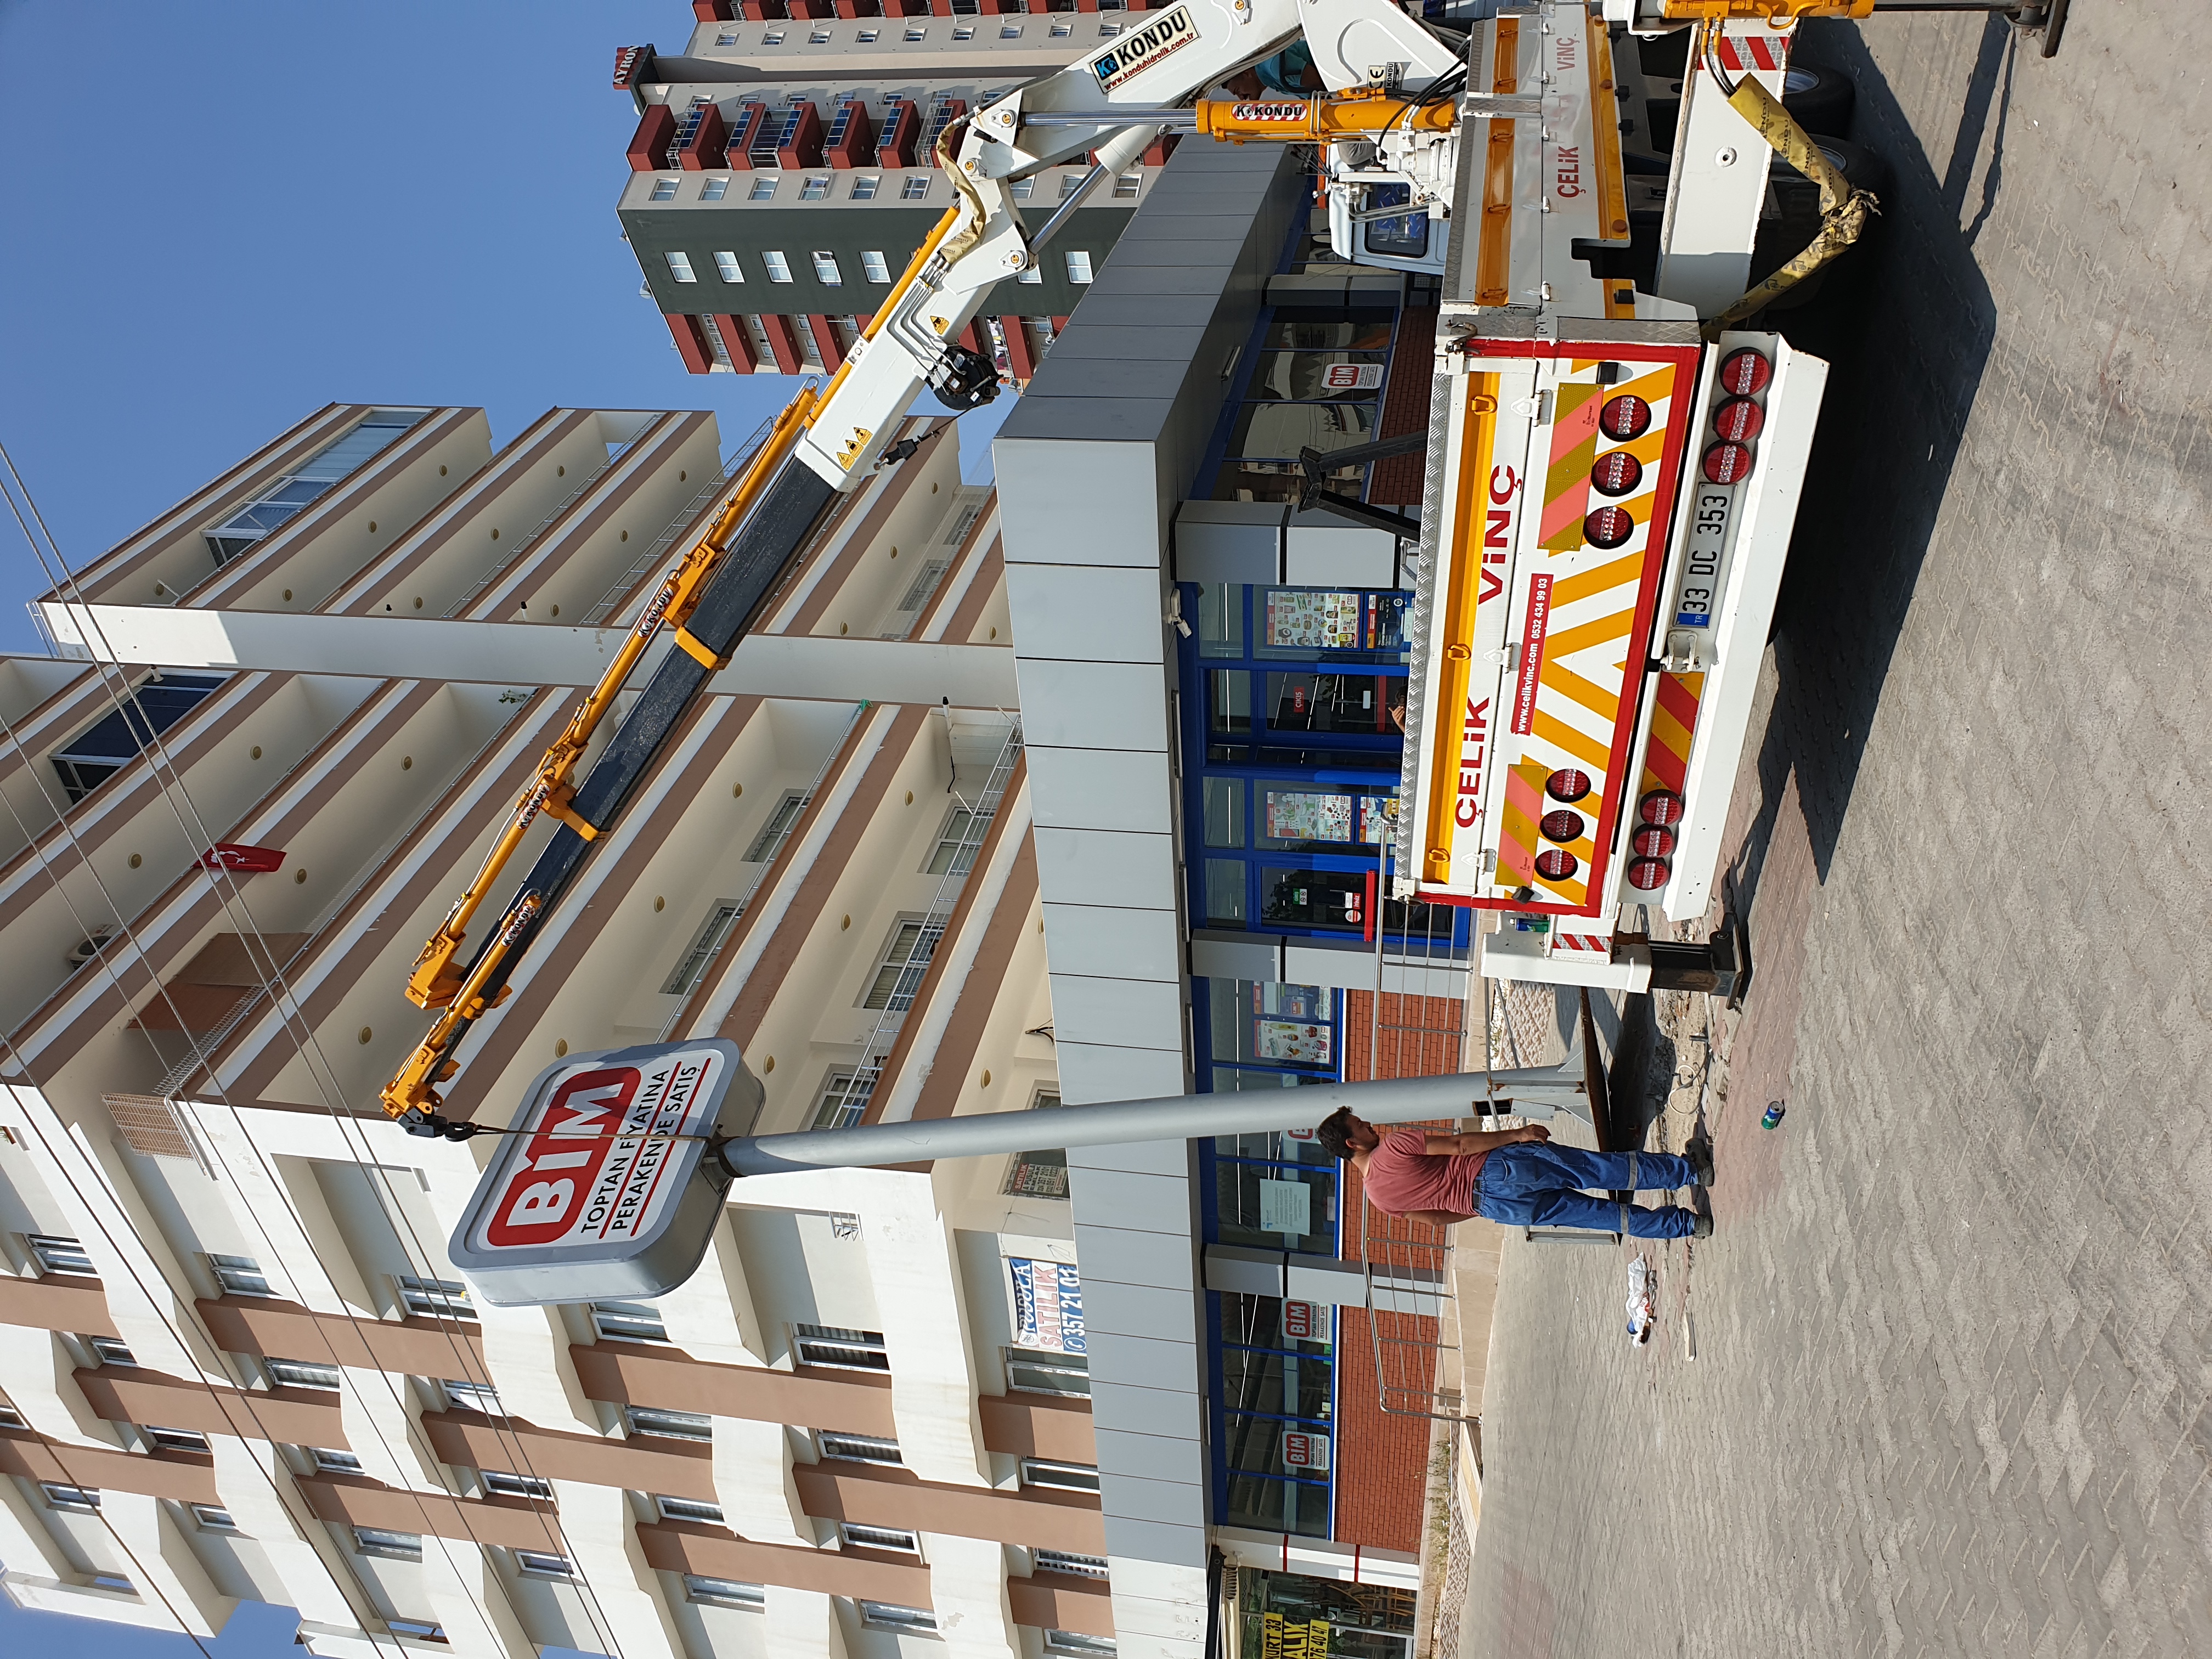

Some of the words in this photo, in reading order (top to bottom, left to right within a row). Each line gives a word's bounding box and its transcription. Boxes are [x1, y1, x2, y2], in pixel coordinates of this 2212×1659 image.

[1114, 8, 1187, 68] KONDU
[613, 44, 640, 84] AYRON
[1103, 32, 1194, 91] www.konduhidrolik.com.tr
[1369, 69, 1384, 89] CE
[1254, 106, 1304, 116] KONDU
[1696, 495, 1728, 535] 353
[1688, 550, 1717, 575] DC
[1538, 578, 1548, 589] 03
[1537, 590, 1547, 601] 99
[1681, 588, 1710, 612] 33
[1534, 602, 1545, 618] 434
[1694, 615, 1703, 624] TR
[1531, 619, 1542, 639] 0532
[1517, 643, 1538, 732] www.celikvinc.com
[611, 1119, 675, 1230] PERAKENDE
[664, 1066, 701, 1112] SATIŞ
[1014, 1164, 1028, 1189] SATILIK
[1024, 1165, 1035, 1185] PUSULA
[1030, 1166, 1041, 1190] EMLAK
[1037, 1177, 1047, 1185] 357
[580, 1156, 630, 1233] TOPTAN
[1058, 1268, 1080, 1287] 01
[1034, 1265, 1063, 1347] SATILIK
[1059, 1291, 1082, 1309] 21
[1061, 1312, 1085, 1336] 357
[1265, 1618, 1282, 1632] 33
[1311, 1625, 1328, 1635] 47
[1310, 1635, 1327, 1646] 40
[1309, 1647, 1325, 1659] 76
